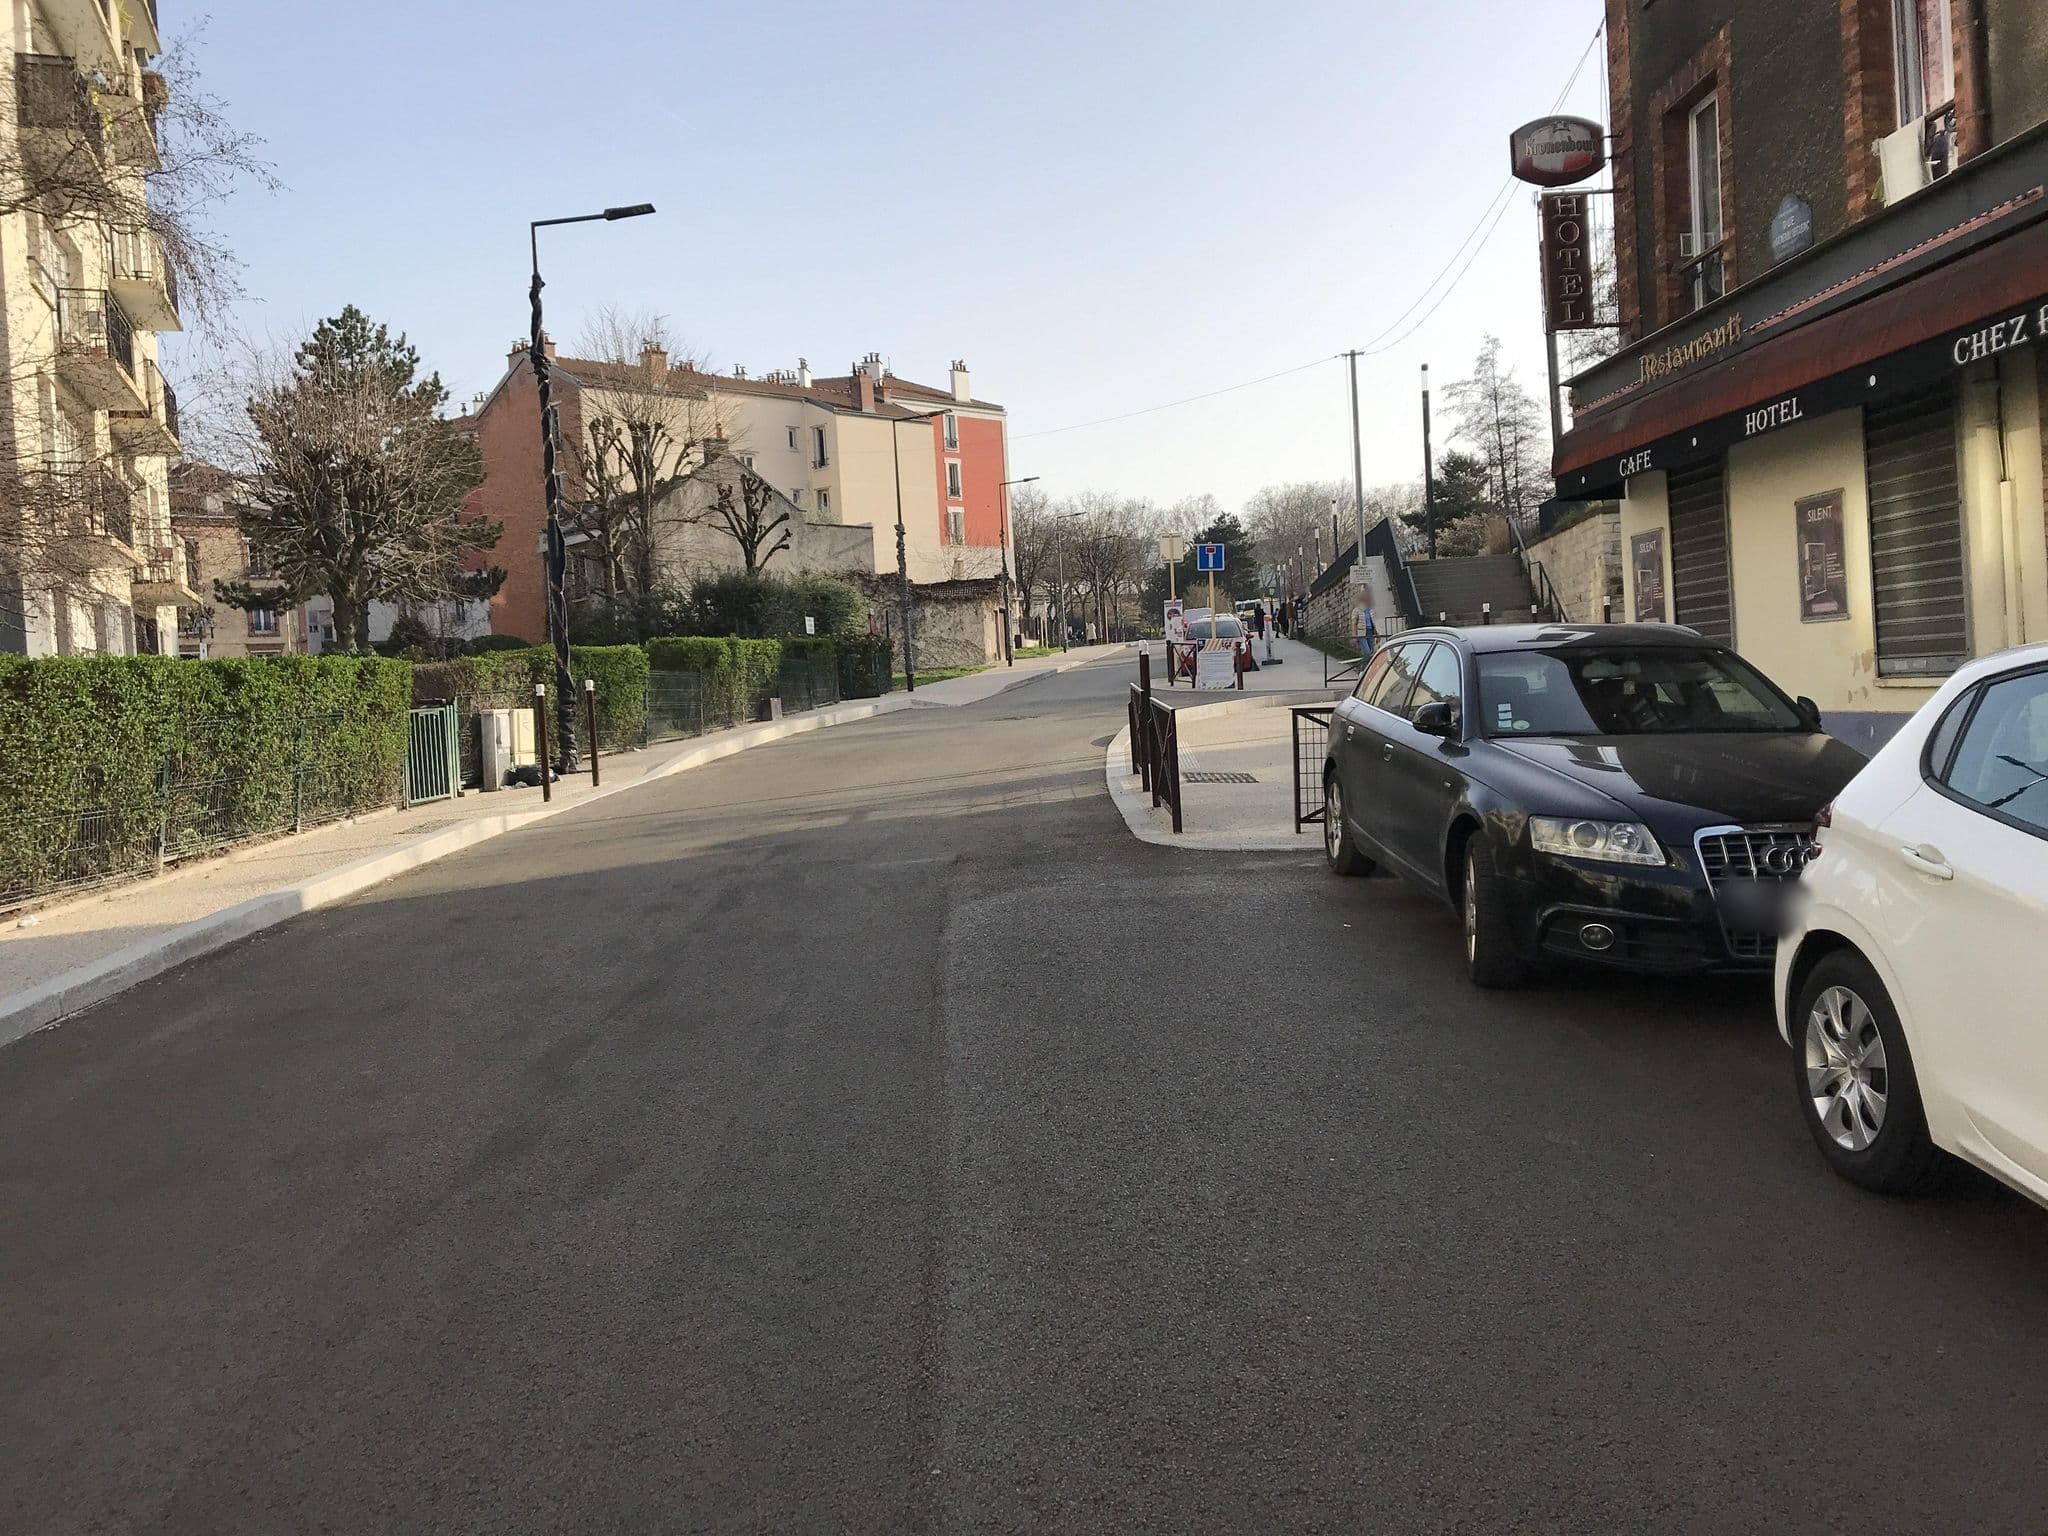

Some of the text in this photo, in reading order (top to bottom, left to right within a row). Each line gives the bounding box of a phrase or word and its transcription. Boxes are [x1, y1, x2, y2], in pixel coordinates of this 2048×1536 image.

[1551, 195, 1585, 323] HOTEL
[1619, 449, 1652, 477] CAFE
[1745, 397, 1803, 436] HOTEL
[1953, 314, 2030, 365] CHEZ
[1807, 505, 1833, 522] SILENT
